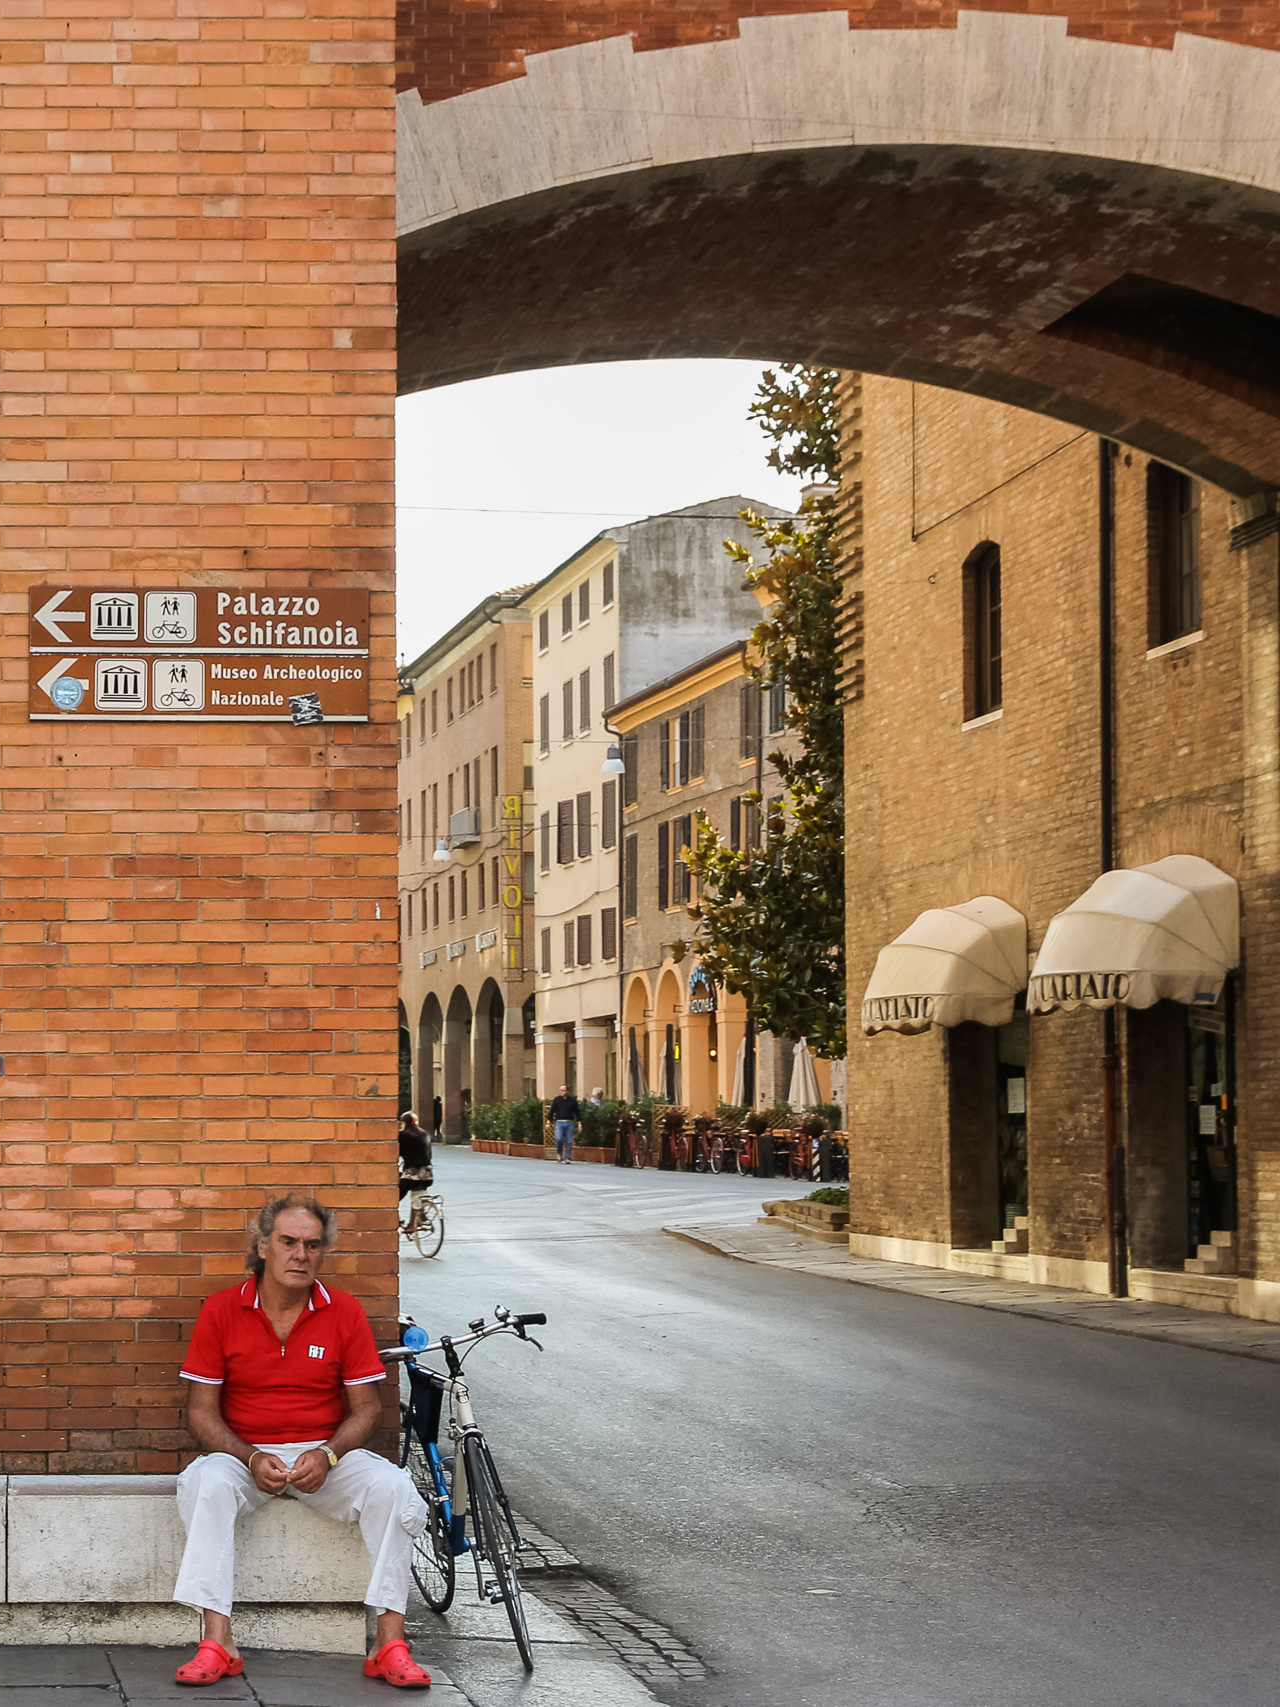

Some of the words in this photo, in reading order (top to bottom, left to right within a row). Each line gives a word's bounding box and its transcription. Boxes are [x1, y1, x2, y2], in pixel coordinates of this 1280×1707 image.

[217, 592, 320, 616] Palazzo
[217, 620, 359, 646] Schifanoia
[211, 663, 258, 680] Museo
[263, 664, 363, 683] Archeologico
[211, 690, 284, 706] Nazionale
